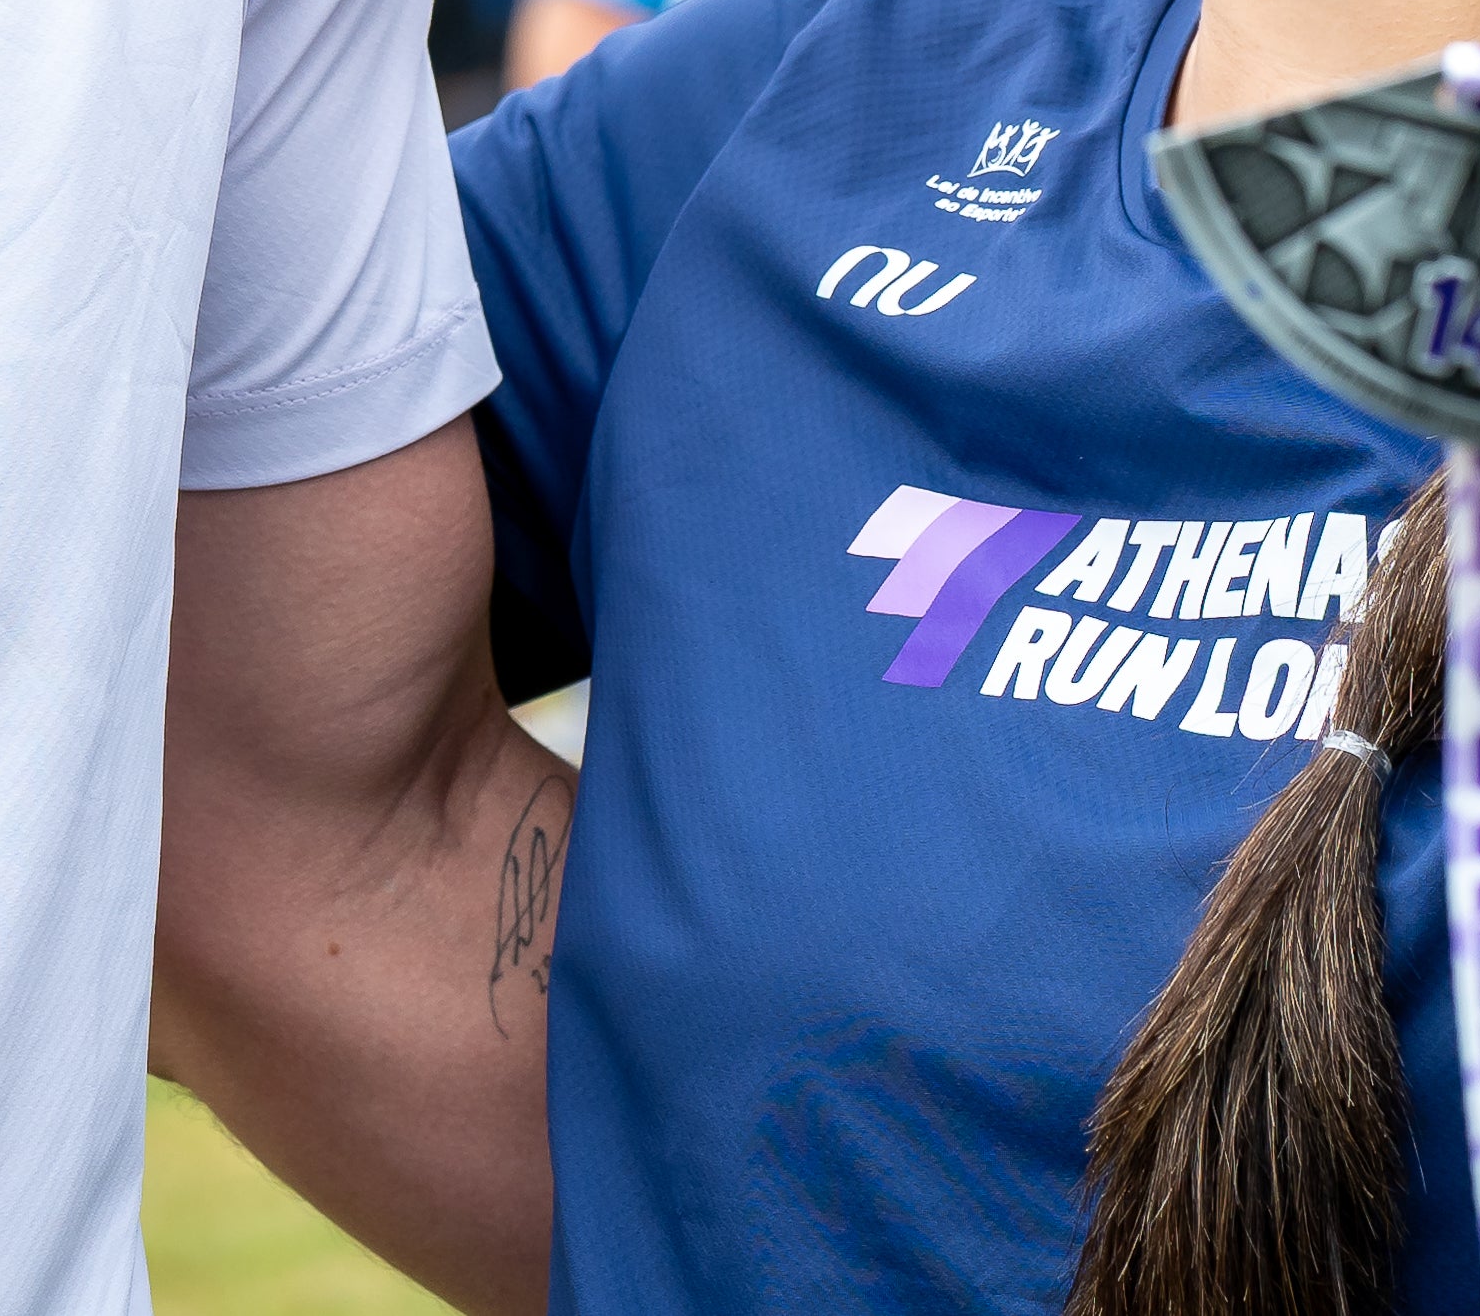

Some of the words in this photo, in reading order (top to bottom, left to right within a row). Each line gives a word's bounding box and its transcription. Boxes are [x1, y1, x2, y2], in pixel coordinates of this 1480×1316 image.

[925, 174, 961, 195] Lei
[956, 186, 980, 201] de
[934, 198, 961, 213] ao
[1034, 510, 1404, 624] ATHENA
[979, 605, 1202, 722] RUN
